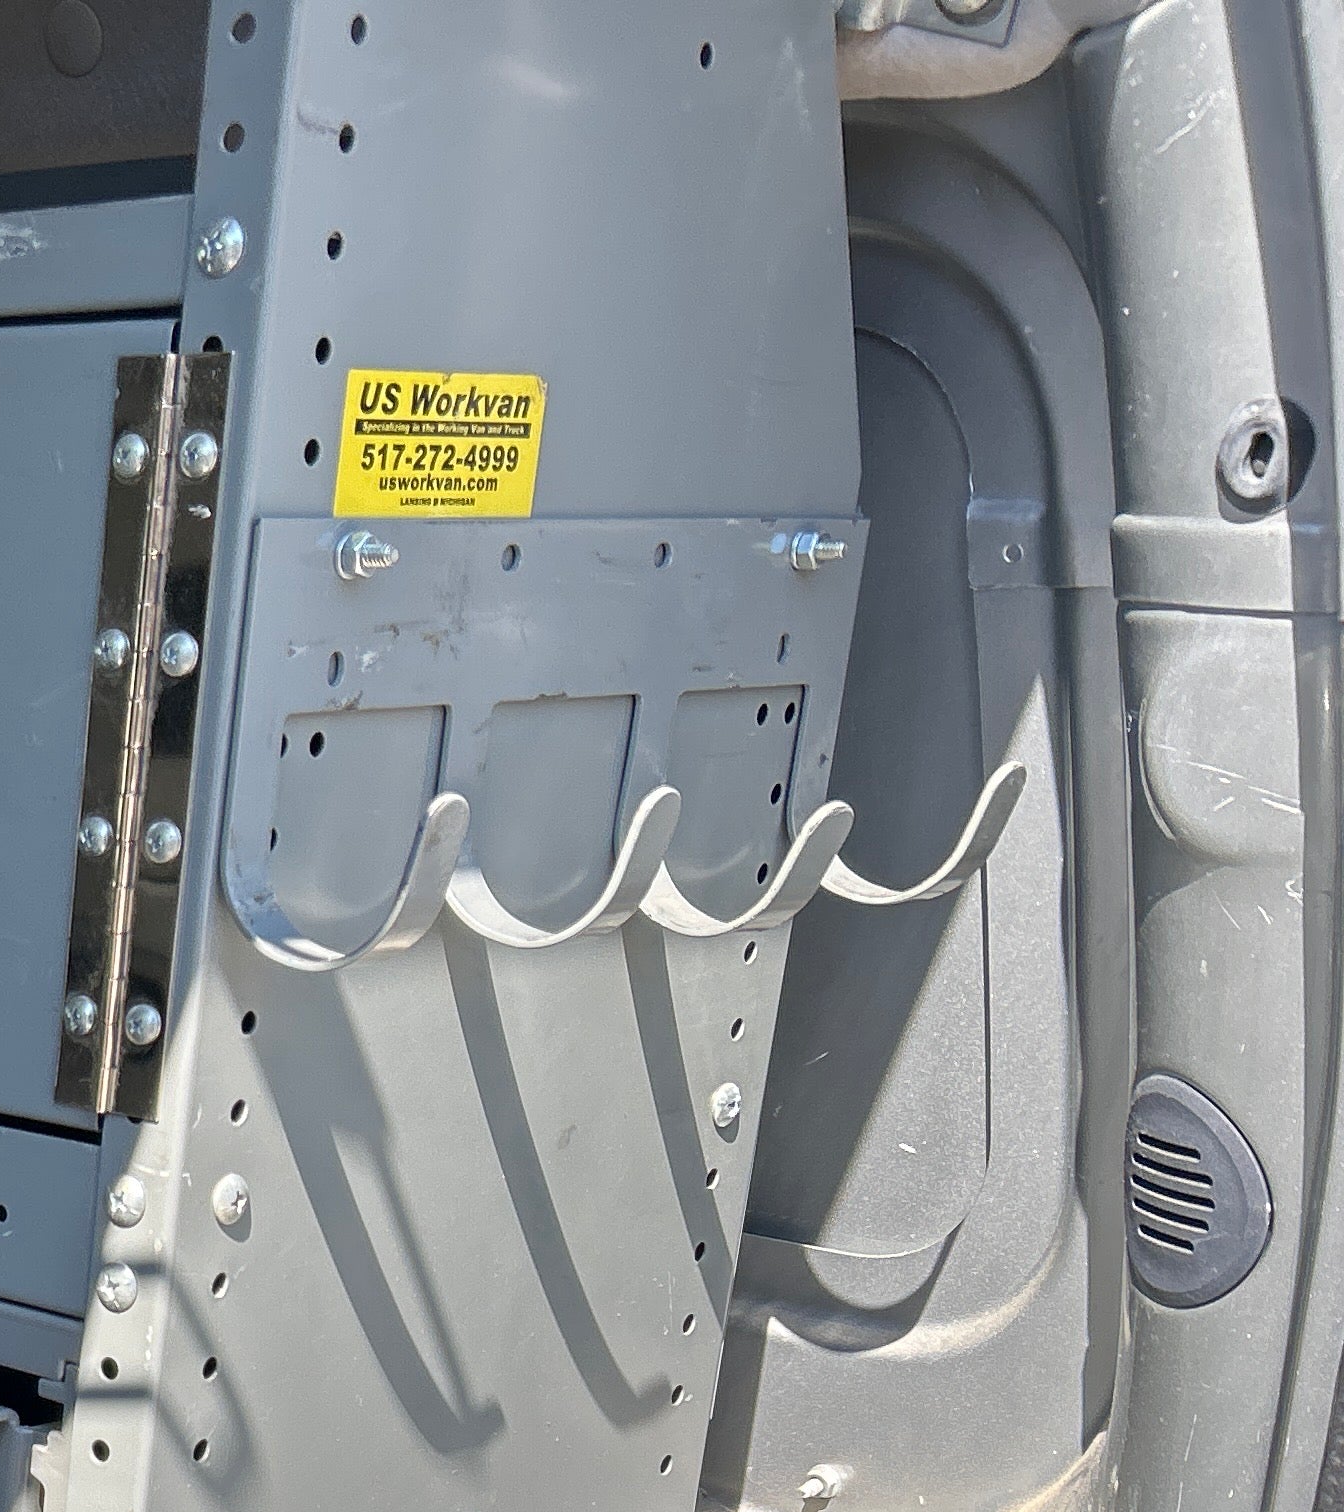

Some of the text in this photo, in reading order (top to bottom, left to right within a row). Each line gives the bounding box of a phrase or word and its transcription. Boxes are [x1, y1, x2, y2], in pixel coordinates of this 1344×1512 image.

[360, 381, 531, 419] US Workvan
[362, 421, 410, 434] Specializing
[438, 424, 469, 435] Working
[471, 425, 486, 434] Van
[488, 425, 503, 435] and
[504, 425, 525, 435] Truck
[361, 443, 519, 472] 517-272-4999
[379, 474, 498, 492] usworkvan.com
